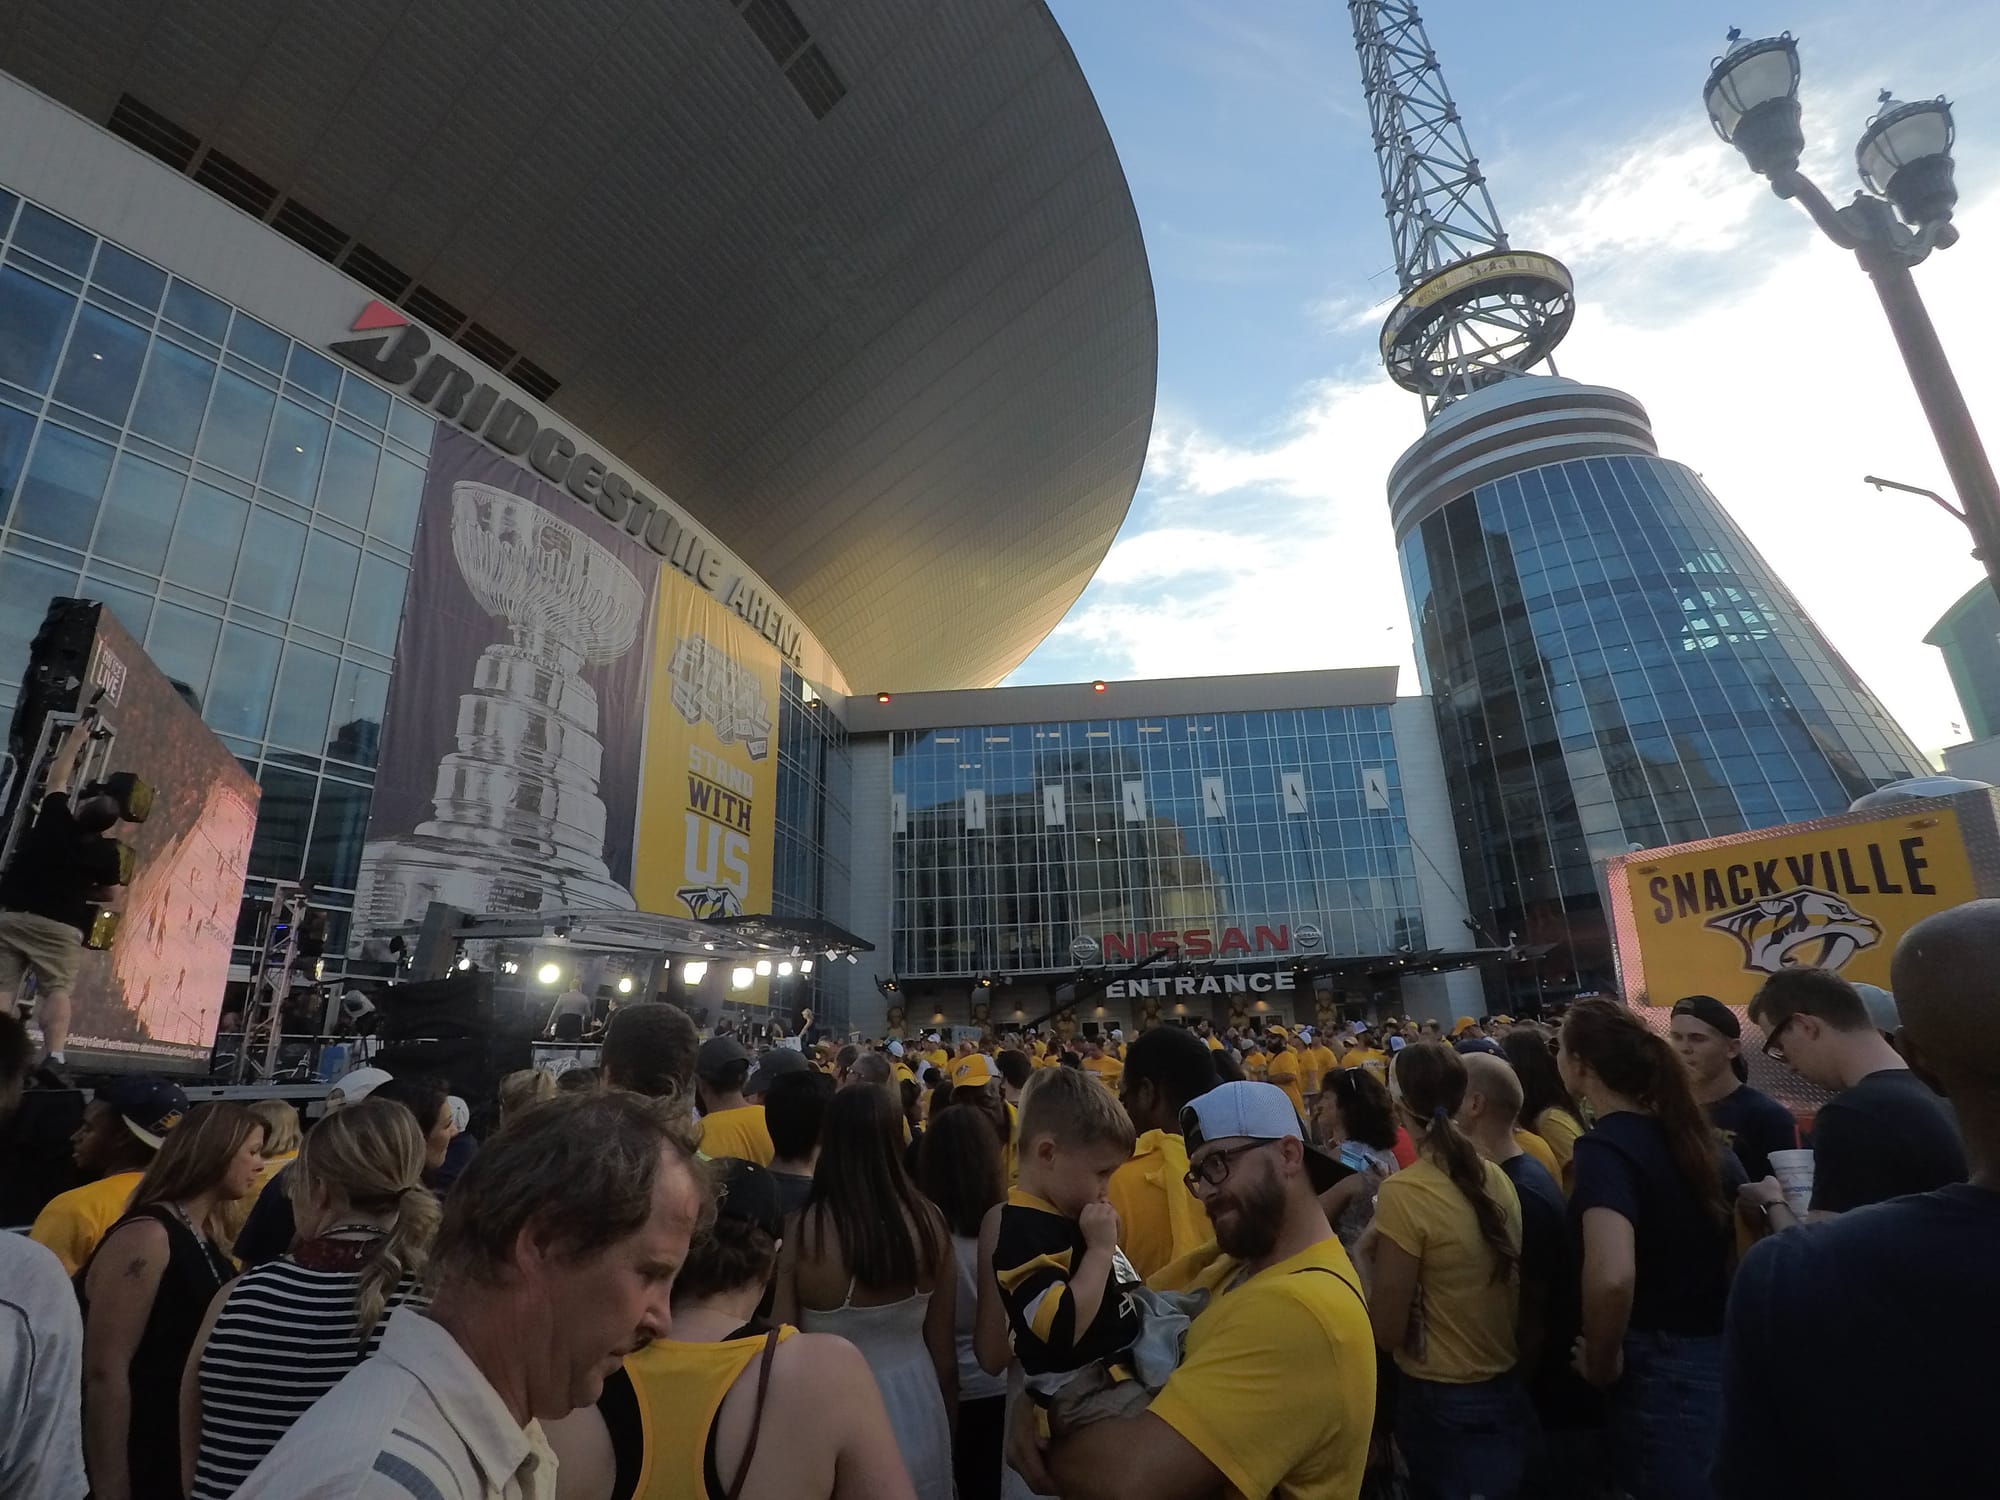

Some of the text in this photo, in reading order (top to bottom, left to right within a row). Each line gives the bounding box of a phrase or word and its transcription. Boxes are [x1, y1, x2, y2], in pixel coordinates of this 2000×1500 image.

[726, 576, 803, 669] ARENA
[97, 663, 119, 698] LIVE
[687, 743, 753, 799] STAND
[687, 775, 753, 832] WITH
[684, 813, 751, 900] US
[1649, 836, 1937, 925] SNACKVILLE
[1102, 924, 1290, 960] NISSAN
[1105, 971, 1296, 999] ENTRANCE
